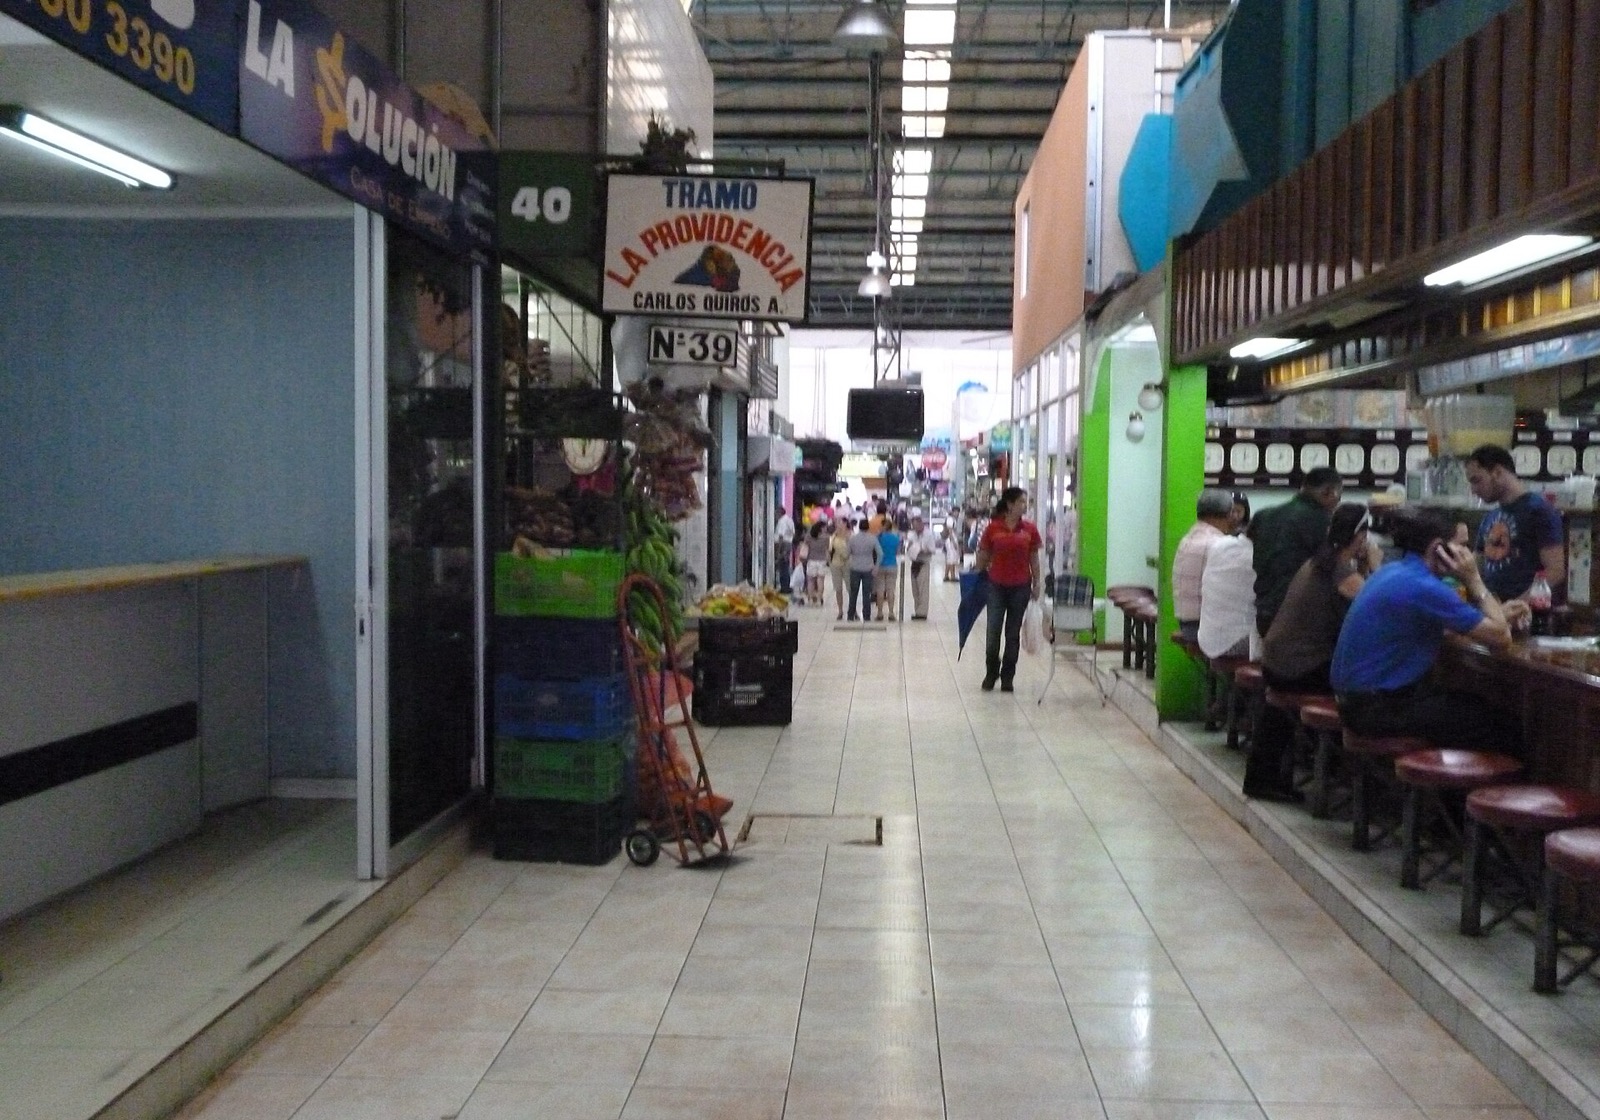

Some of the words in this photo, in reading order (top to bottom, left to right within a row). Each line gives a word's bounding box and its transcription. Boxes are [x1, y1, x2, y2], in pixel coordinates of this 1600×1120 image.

[106, 1, 195, 95] 3390
[245, 0, 295, 99] LA
[510, 186, 571, 223] 40
[662, 179, 757, 210] TRAMO
[606, 247, 648, 288] LA
[639, 212, 804, 293] PROVIDENCIA
[633, 291, 696, 310] CARLOS
[688, 331, 732, 363] 39
